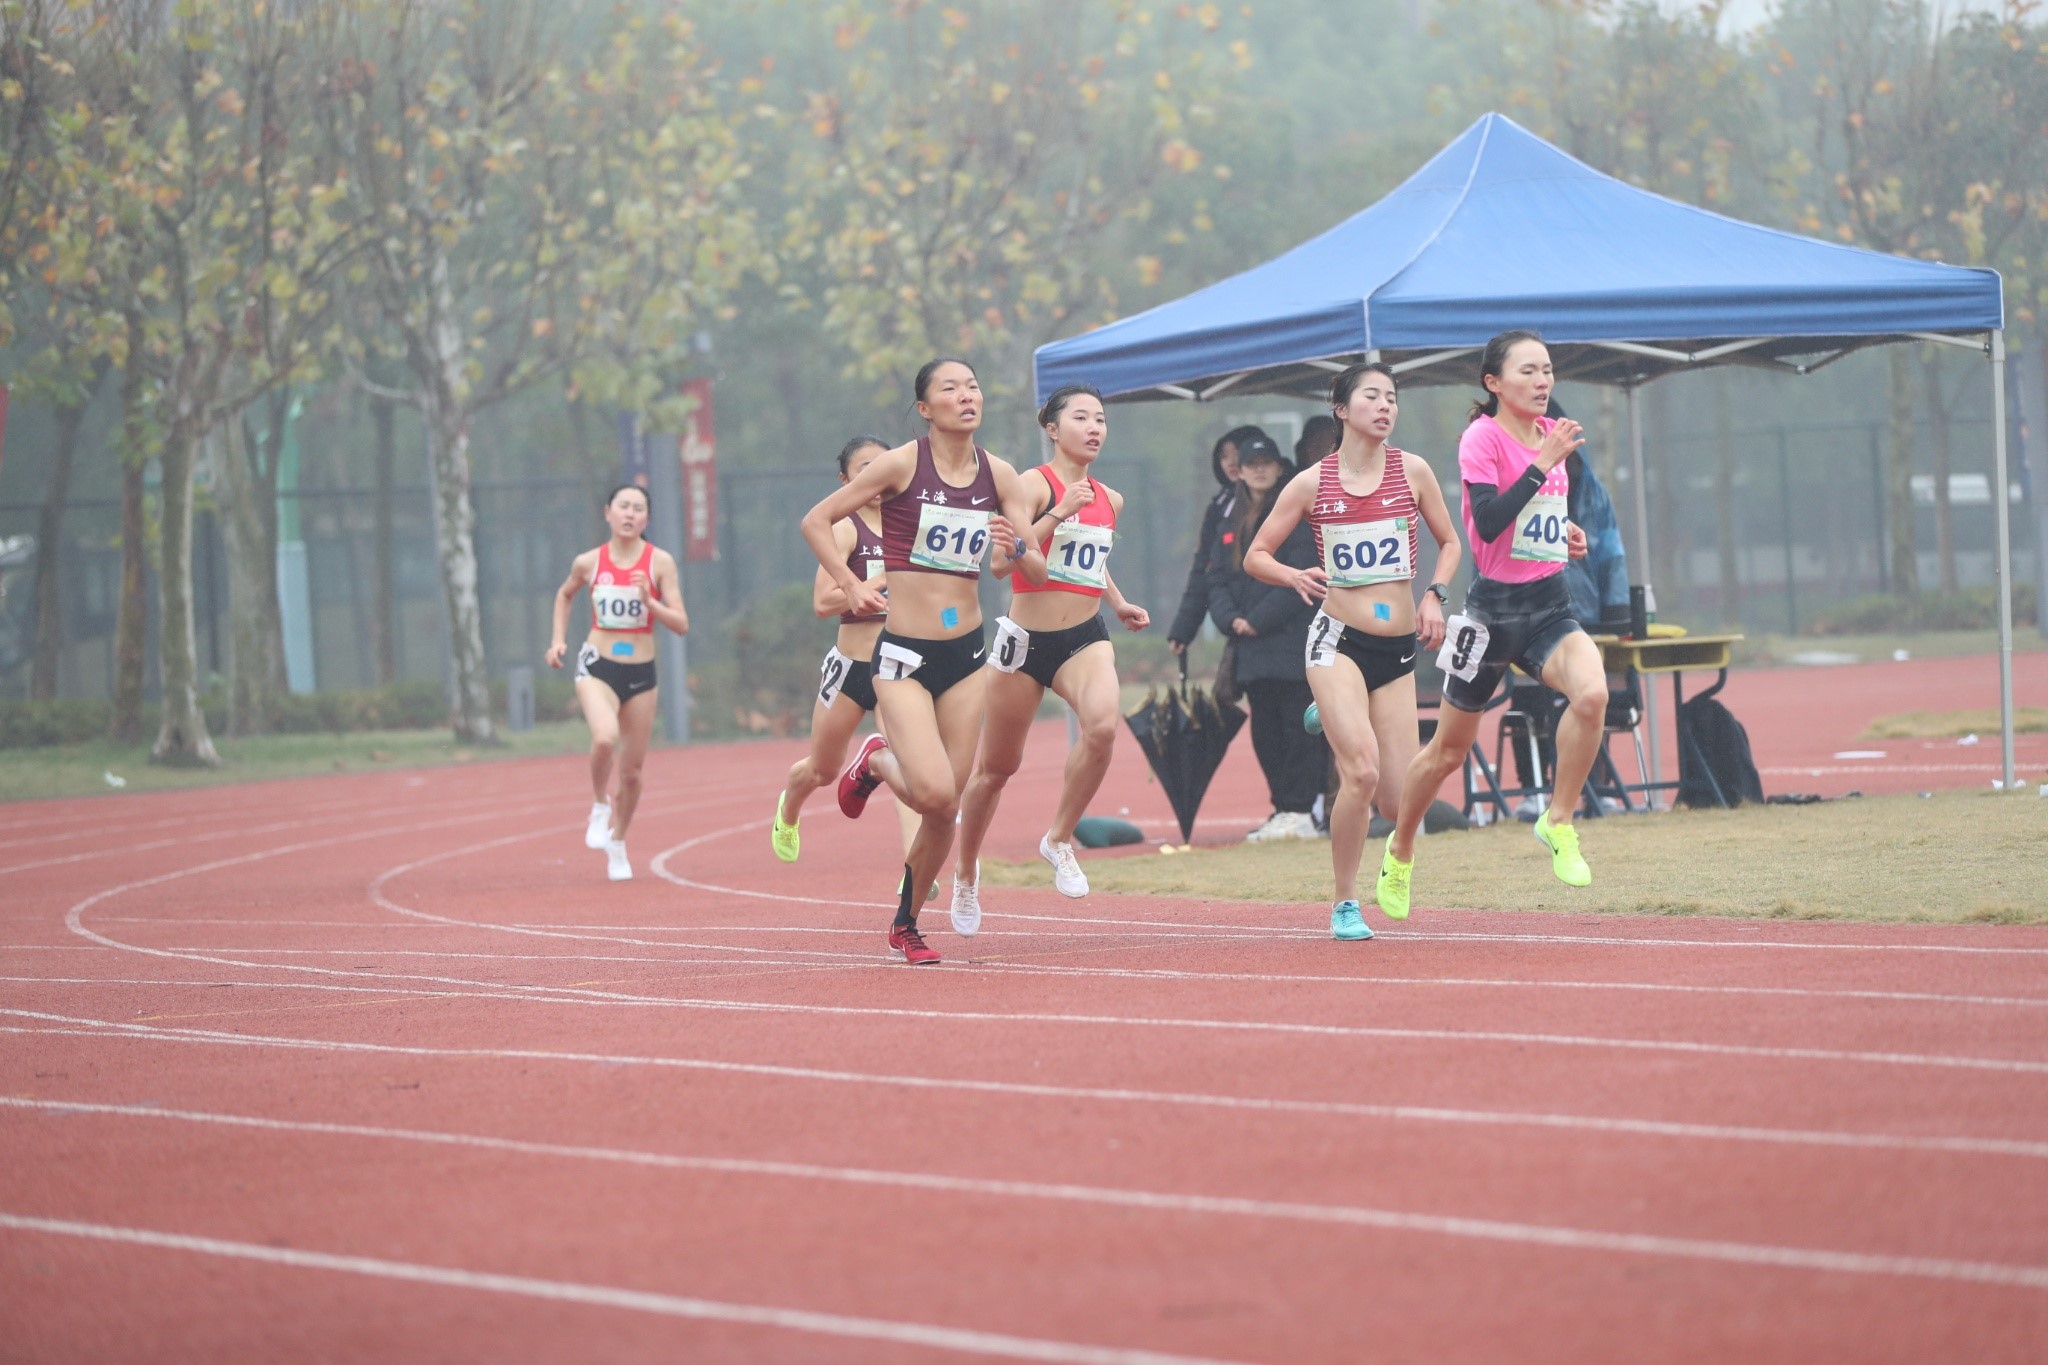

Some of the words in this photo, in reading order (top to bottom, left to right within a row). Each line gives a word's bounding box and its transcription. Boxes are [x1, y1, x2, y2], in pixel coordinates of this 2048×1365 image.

[916, 489, 948, 504] 上海
[1320, 500, 1348, 514] 上海
[925, 524, 987, 556] 616
[1060, 540, 1110, 573] 107
[1332, 537, 1401, 571] 602
[598, 598, 642, 617] 108
[1311, 616, 1330, 661] 2
[1452, 625, 1476, 671] 9
[820, 655, 843, 702] 12
